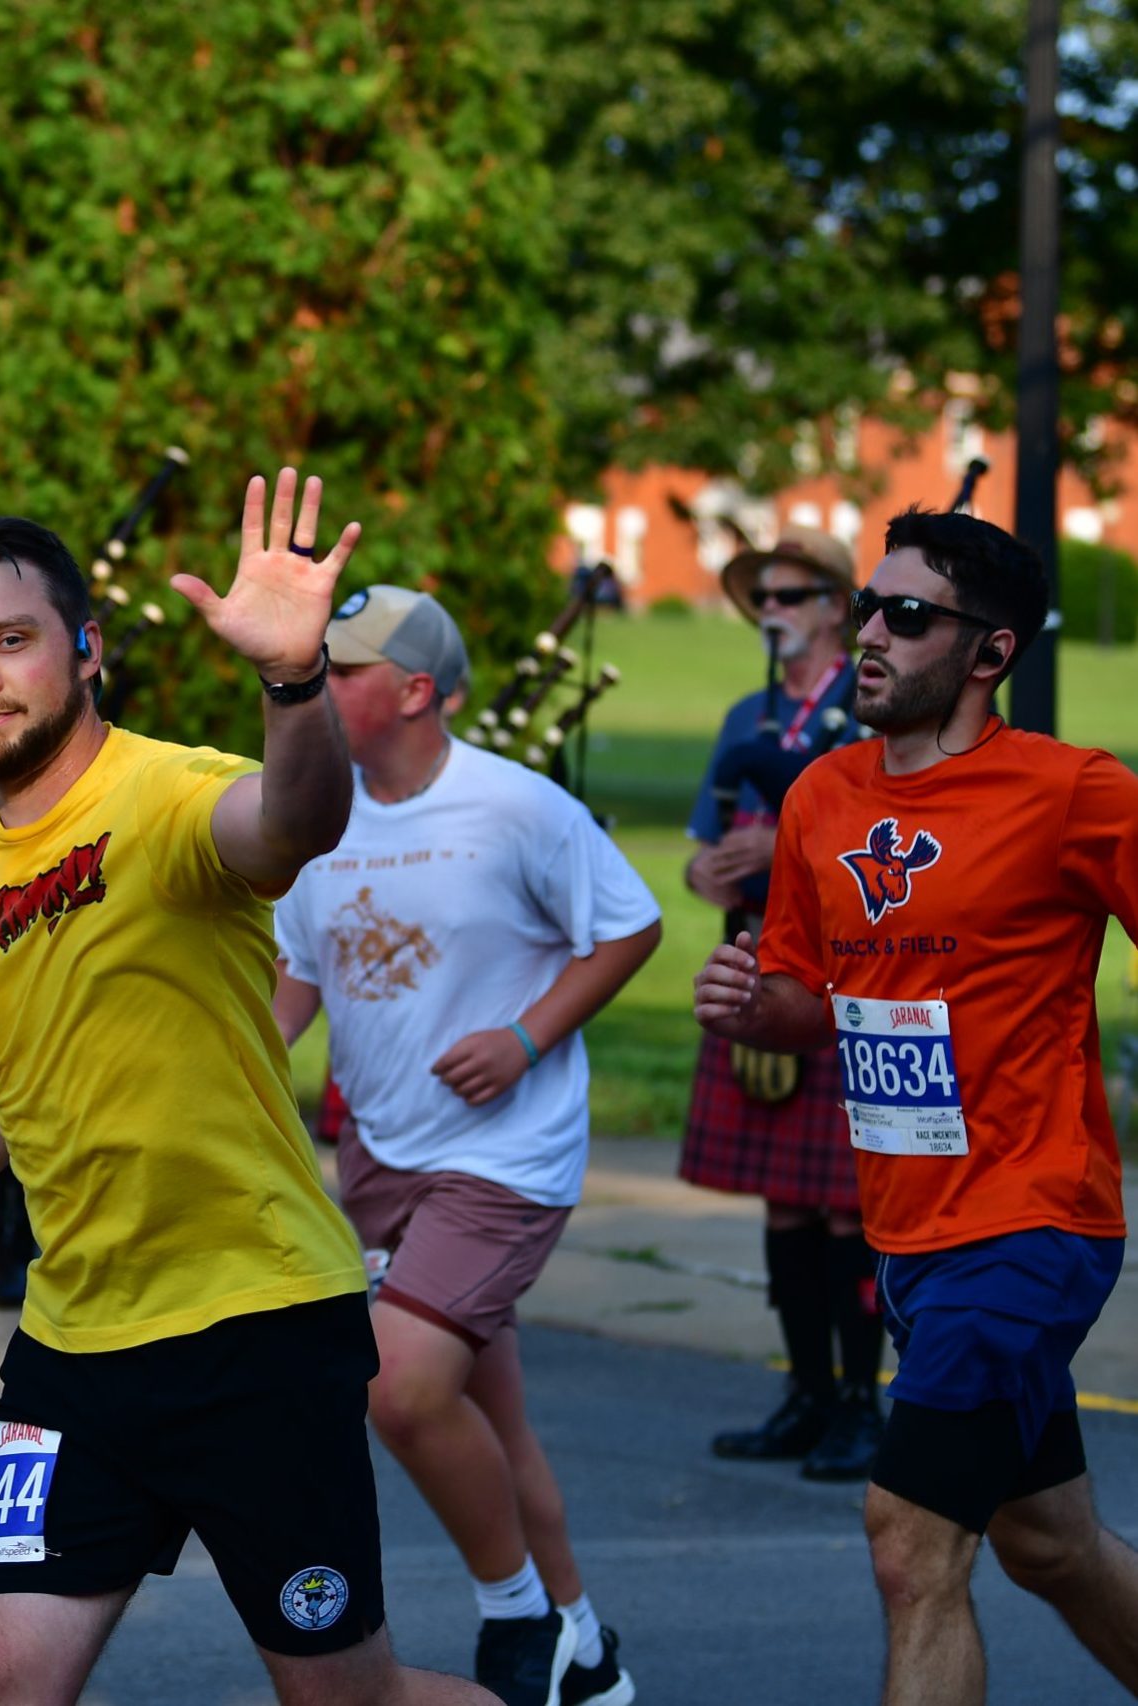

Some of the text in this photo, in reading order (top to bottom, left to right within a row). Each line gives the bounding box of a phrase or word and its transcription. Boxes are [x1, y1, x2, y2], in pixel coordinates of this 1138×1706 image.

[830, 938, 880, 957] RACK
[900, 936, 958, 954] FIELD
[889, 1006, 934, 1029] SARANAC
[839, 1037, 955, 1097] 18634
[915, 1130, 961, 1140] RACE INCENTIVE
[929, 1142, 952, 1152] 18634
